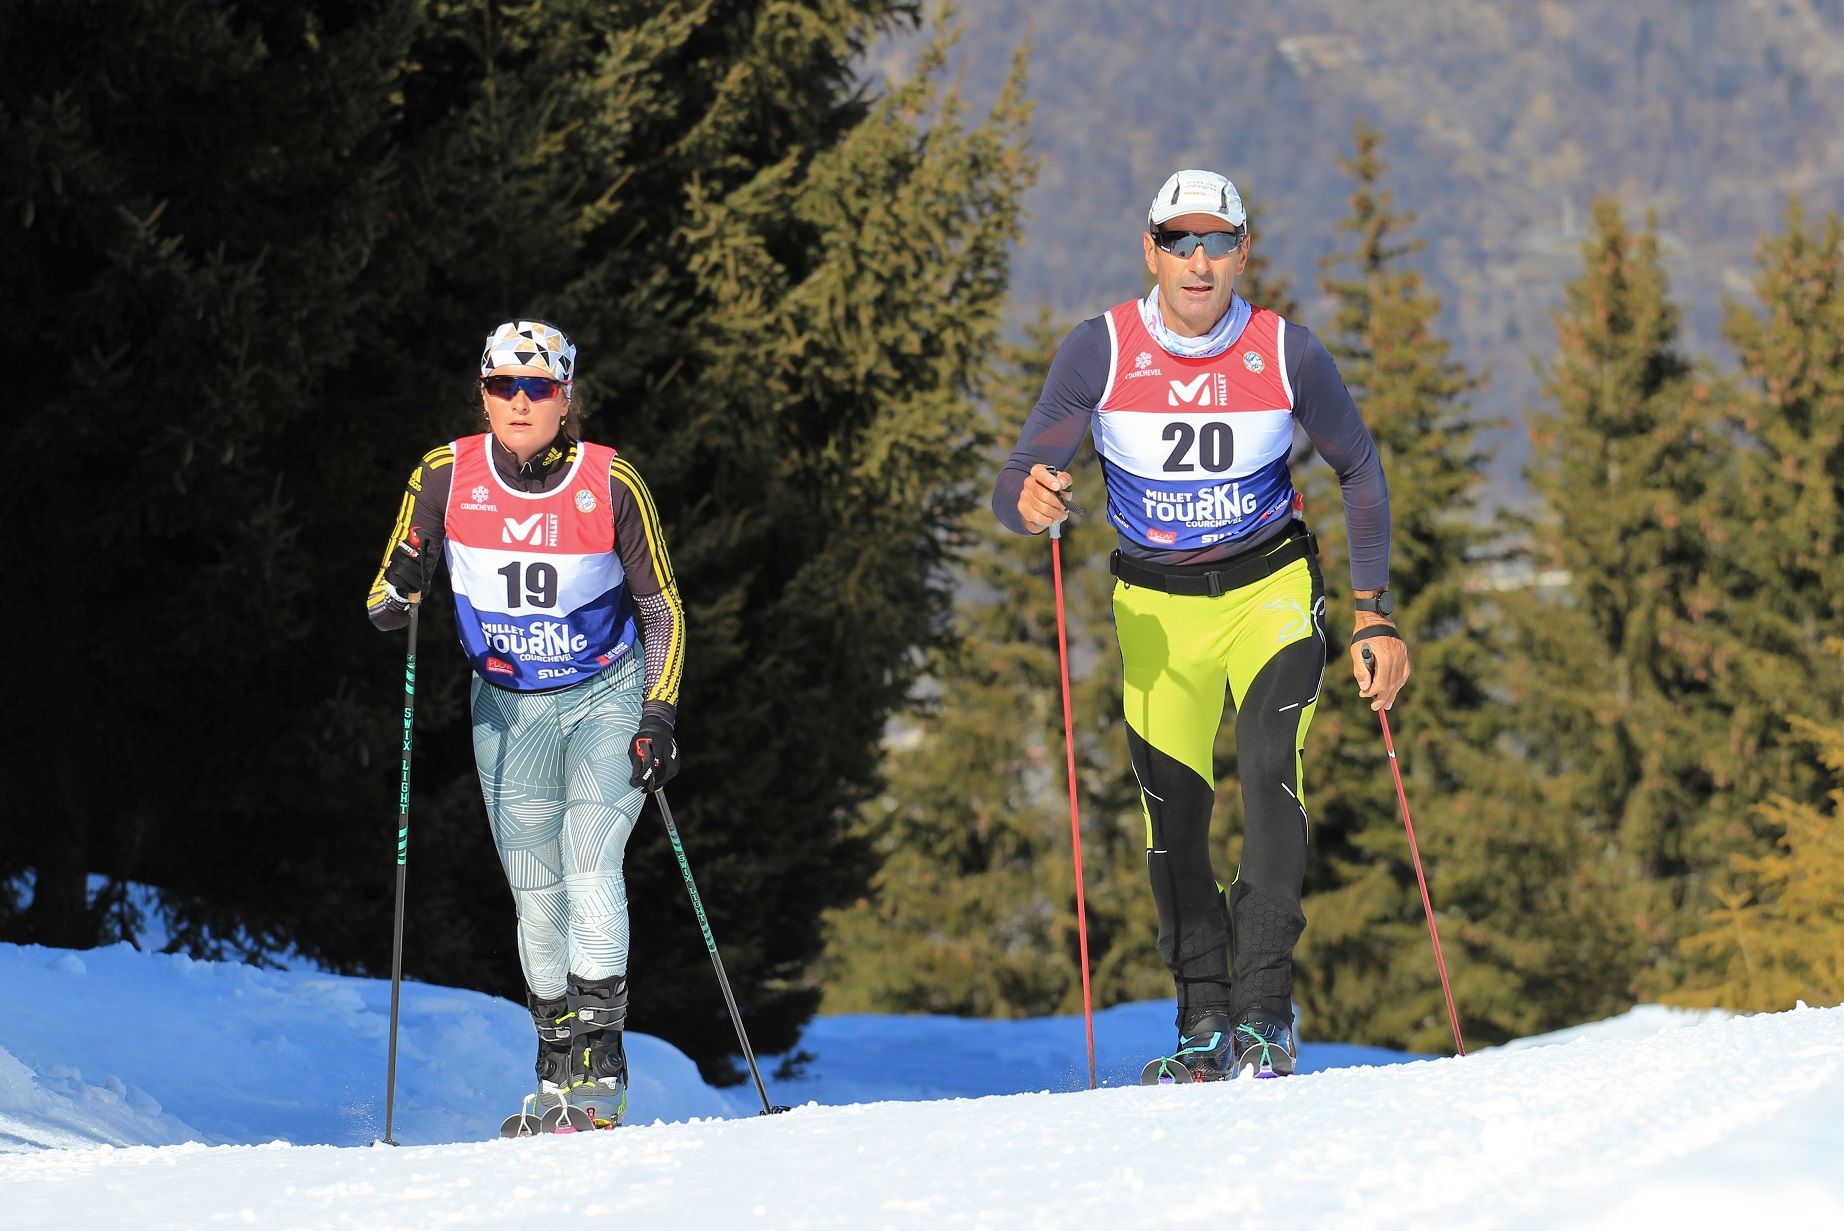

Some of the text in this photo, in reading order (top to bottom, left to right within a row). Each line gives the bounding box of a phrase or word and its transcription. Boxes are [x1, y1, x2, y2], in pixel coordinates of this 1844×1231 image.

[1219, 373, 1228, 406] MILLET
[1161, 421, 1234, 473] 20
[460, 503, 498, 512] COURCHEVEL
[1142, 493, 1257, 523] TOURING
[1144, 488, 1193, 504] MILLET
[549, 513, 559, 547] MILLET
[1185, 517, 1243, 528] COURCHEVEL
[497, 561, 558, 609] 19
[481, 621, 525, 635] MILLET
[484, 632, 588, 657] TOURING
[519, 653, 574, 663] COURCHEVEL
[537, 667, 578, 680] SILVA
[399, 707, 413, 815] SWIX LIGHT
